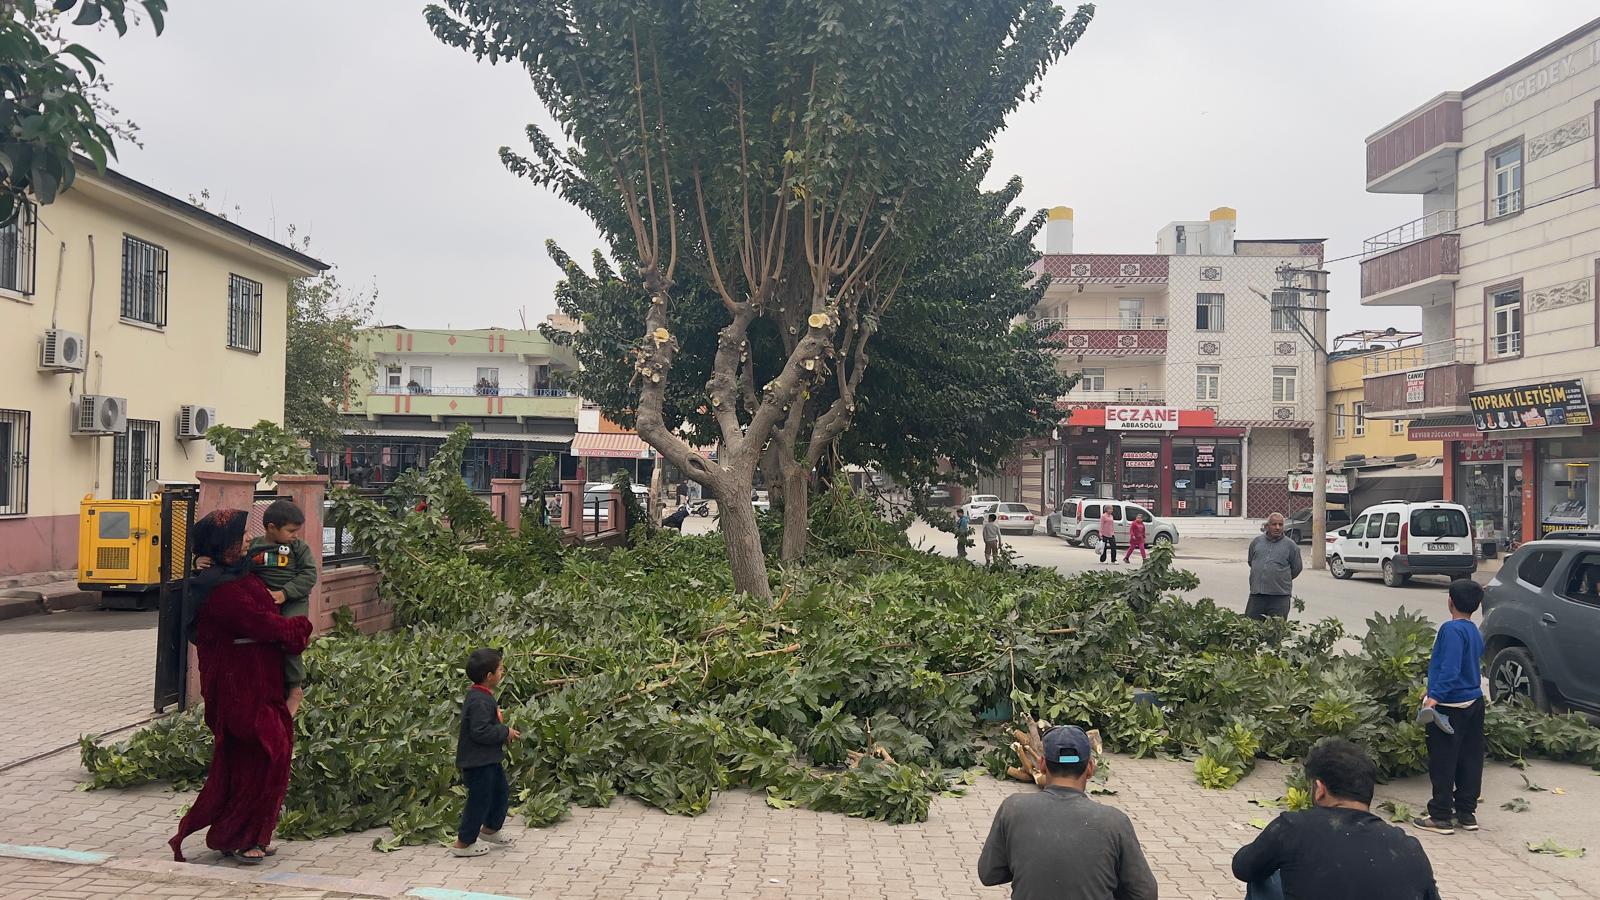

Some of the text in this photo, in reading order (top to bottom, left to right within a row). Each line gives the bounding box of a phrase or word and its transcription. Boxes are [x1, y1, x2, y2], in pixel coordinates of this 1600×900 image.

[1471, 393, 1514, 411] TOPRAK
[1513, 384, 1567, 407] İLETİŞİM
[1107, 408, 1177, 421] ECZANE
